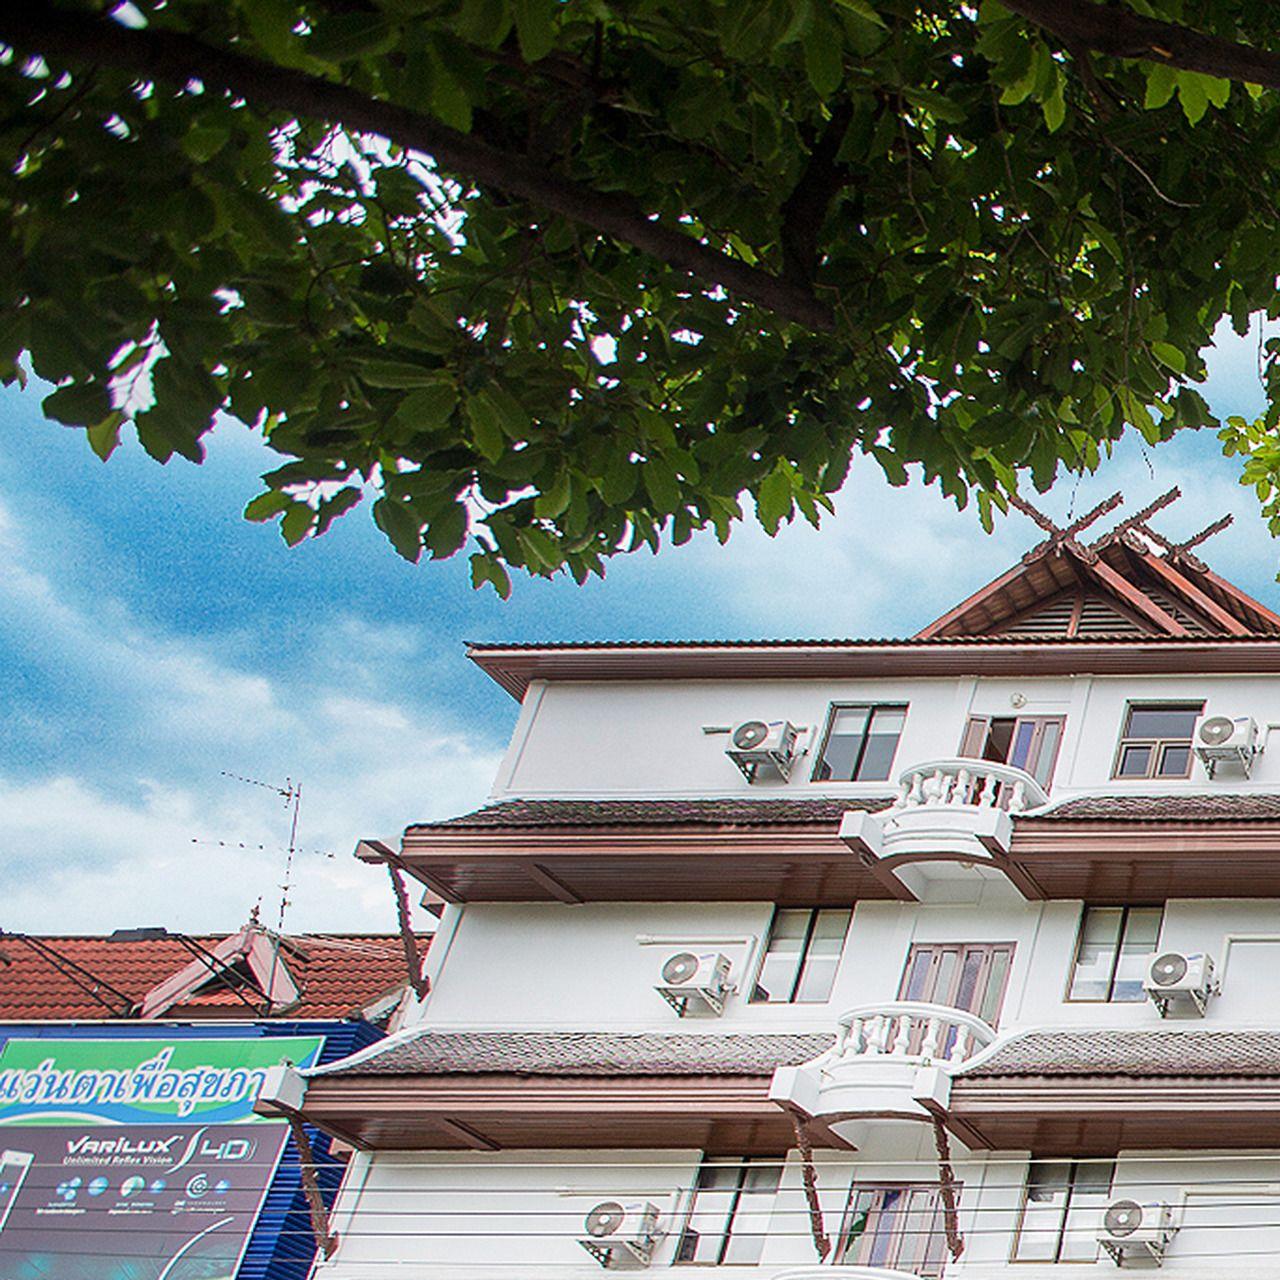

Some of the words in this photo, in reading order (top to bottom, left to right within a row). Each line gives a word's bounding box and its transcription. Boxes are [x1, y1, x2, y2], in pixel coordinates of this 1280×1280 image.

[0, 1048, 264, 1117] แว่นตาเพื่อสุขภา
